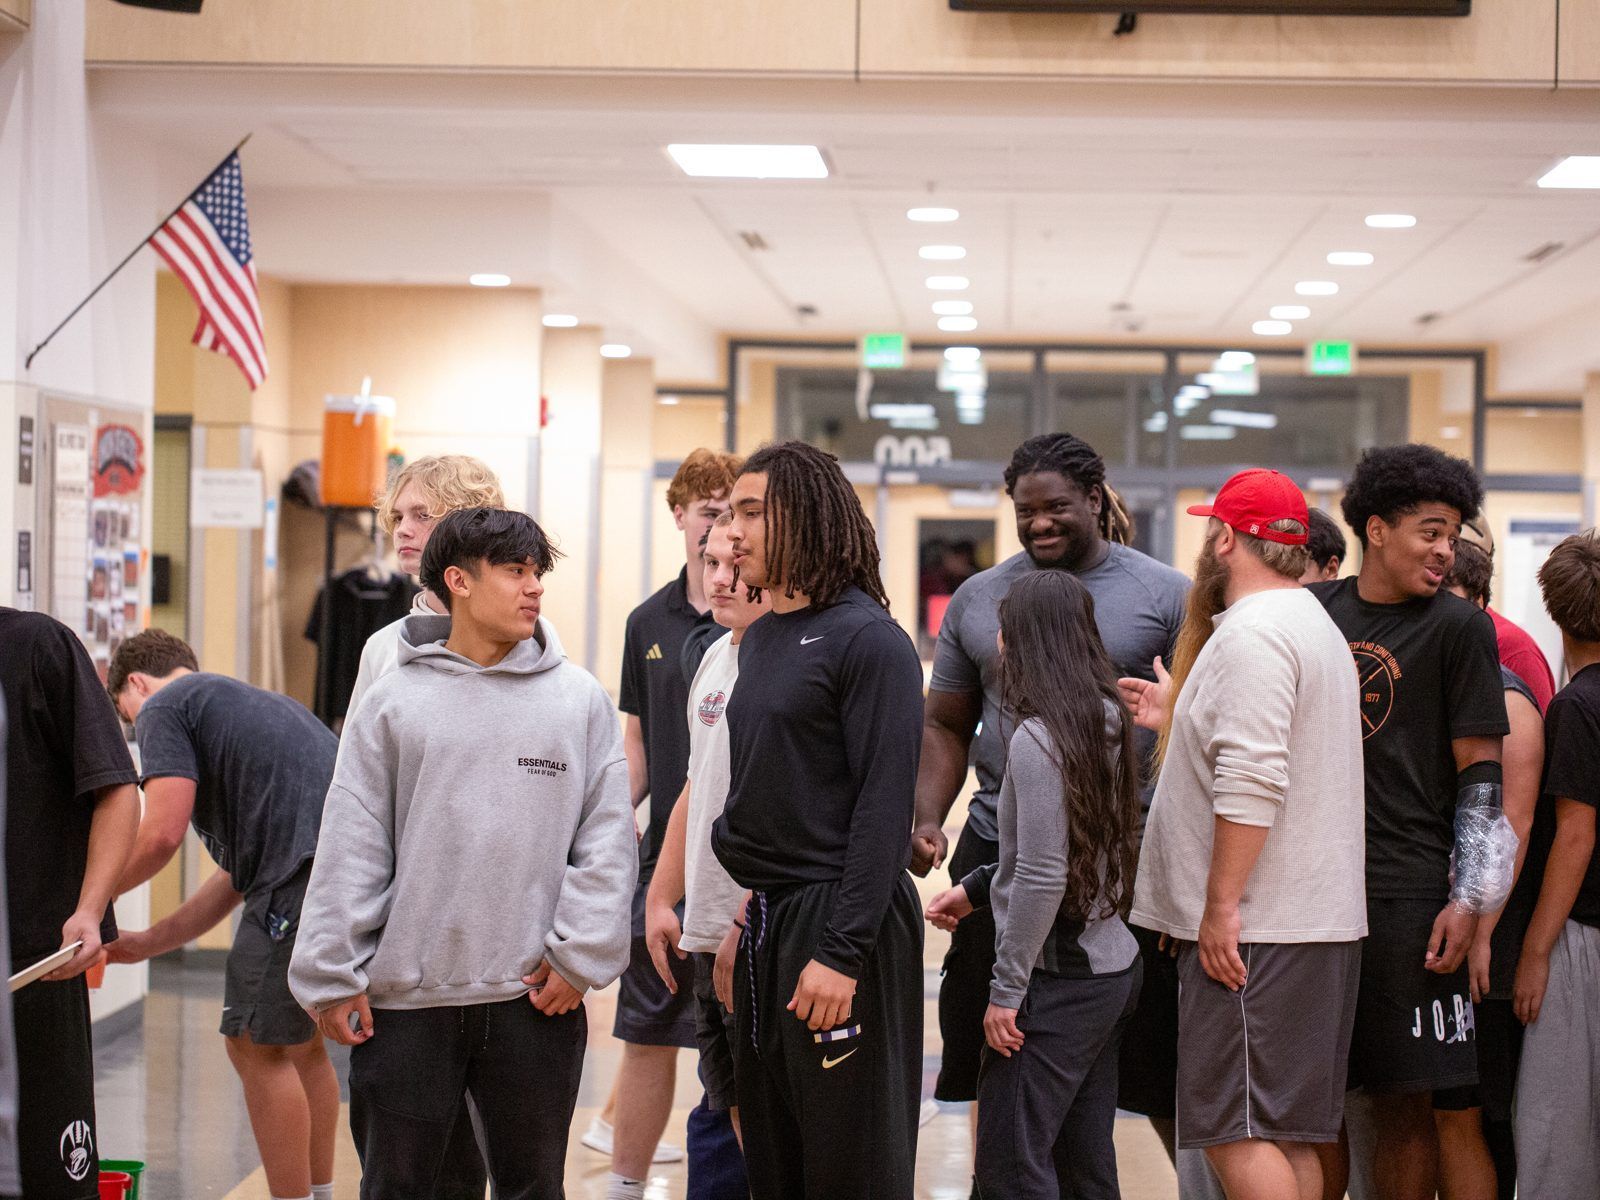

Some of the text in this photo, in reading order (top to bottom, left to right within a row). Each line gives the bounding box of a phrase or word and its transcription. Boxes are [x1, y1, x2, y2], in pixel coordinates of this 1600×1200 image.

[1361, 641, 1375, 650] AND
[1365, 693, 1380, 702] 1977
[518, 758, 567, 771] ESSENTIALS
